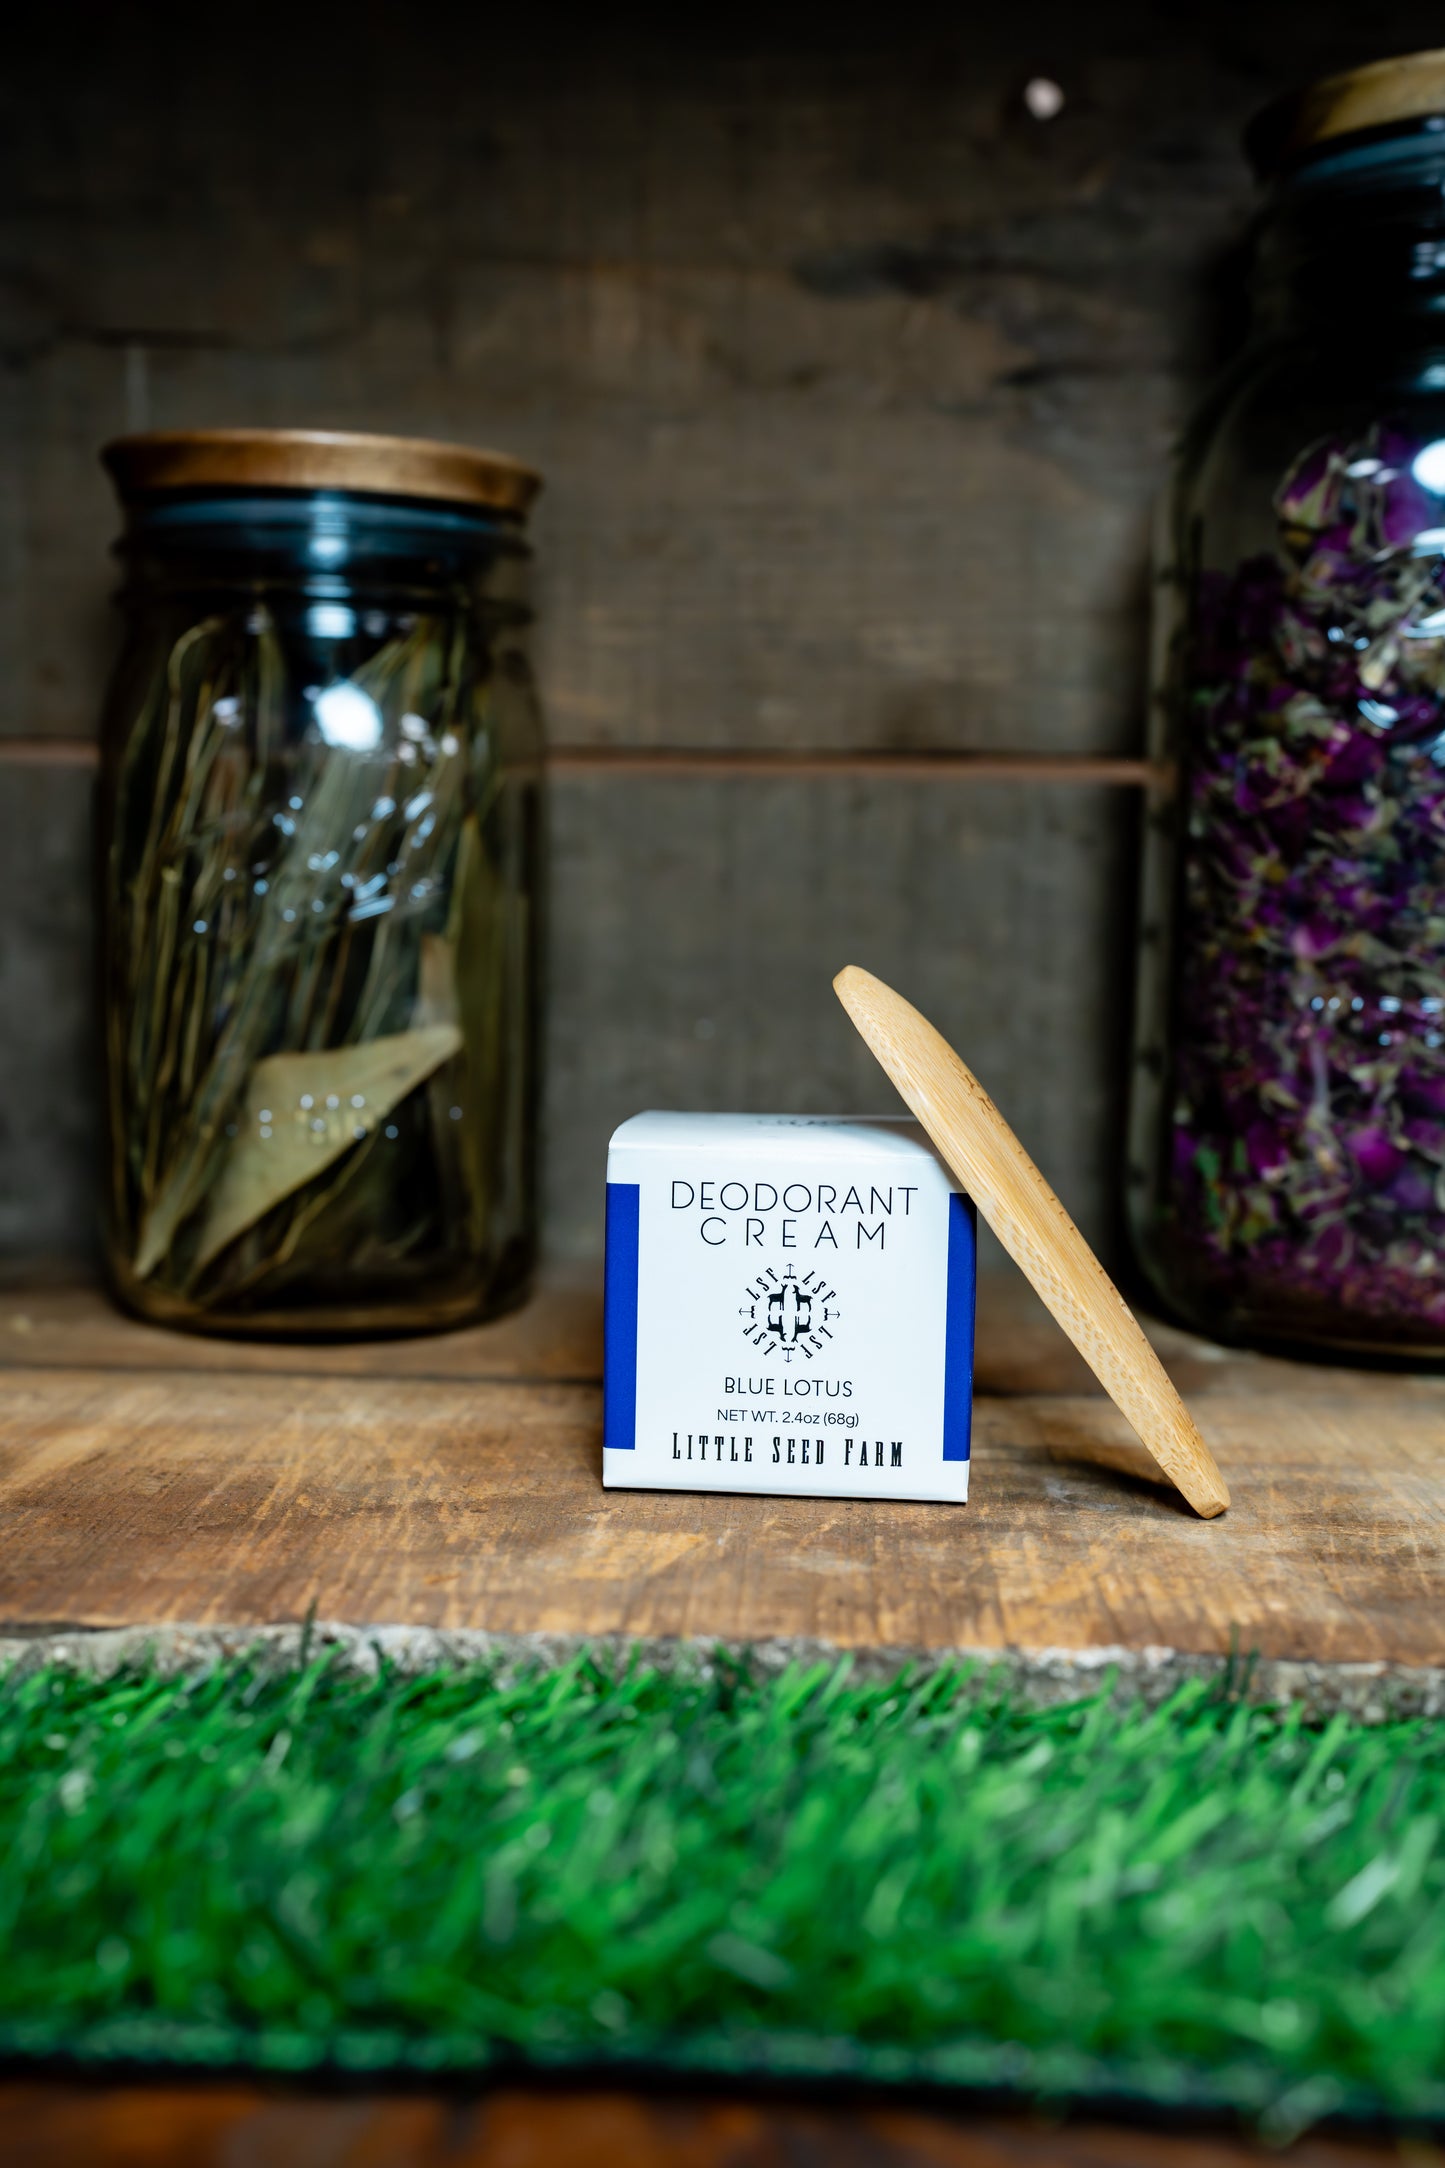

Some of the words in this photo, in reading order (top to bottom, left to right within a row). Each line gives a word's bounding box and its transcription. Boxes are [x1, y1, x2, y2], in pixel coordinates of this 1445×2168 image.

[671, 1180, 919, 1216] DEODORANT
[700, 1217, 885, 1251] CREAM
[746, 1267, 778, 1301] LSF
[801, 1270, 837, 1303] LSF
[724, 1376, 775, 1396] BLUE
[784, 1378, 853, 1398] LOTUS
[717, 1408, 748, 1422] NET
[750, 1410, 779, 1423] WT.
[782, 1411, 821, 1425] 2.4oz
[823, 1411, 860, 1429] (68g)
